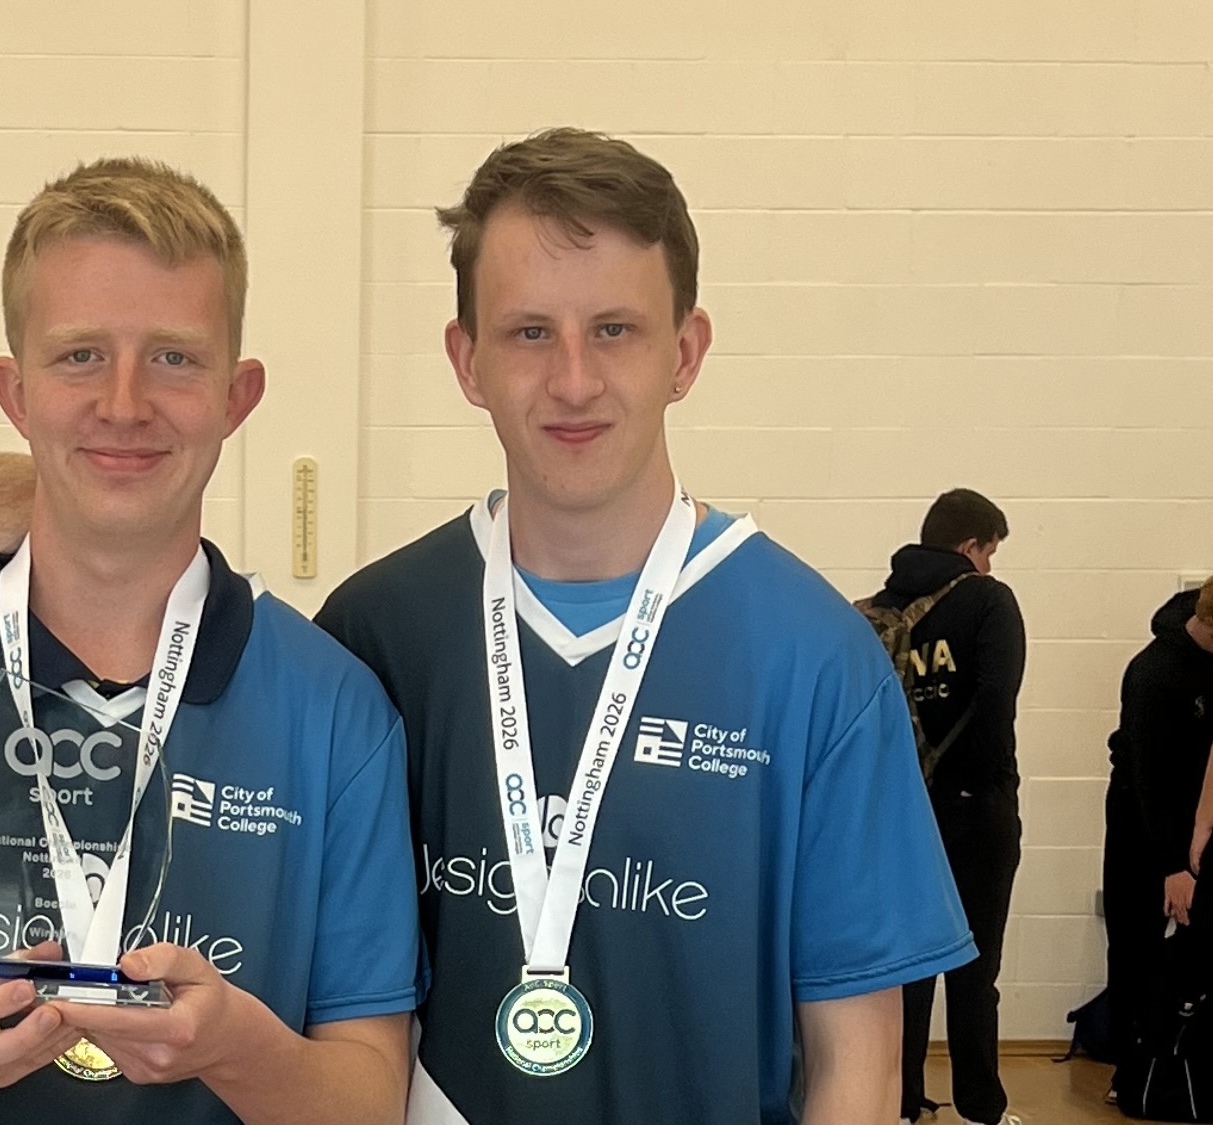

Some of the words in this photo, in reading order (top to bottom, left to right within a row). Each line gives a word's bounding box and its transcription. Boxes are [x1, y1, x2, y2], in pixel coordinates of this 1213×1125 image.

[491, 597, 512, 702] Nottingham
[154, 620, 191, 720] Nottingham
[500, 706, 519, 750] 2026
[693, 723, 727, 743] City
[730, 728, 747, 742] of
[142, 720, 163, 768] 2026
[568, 740, 611, 846] Nottingham
[600, 692, 627, 737] 2026
[688, 755, 748, 778] College
[221, 785, 254, 803] City
[256, 787, 274, 801] of
[219, 800, 302, 826] Portsmouth
[217, 816, 277, 836] College
[39, 837, 129, 853] Cpionshi
[526, 1039, 562, 1051] sport
